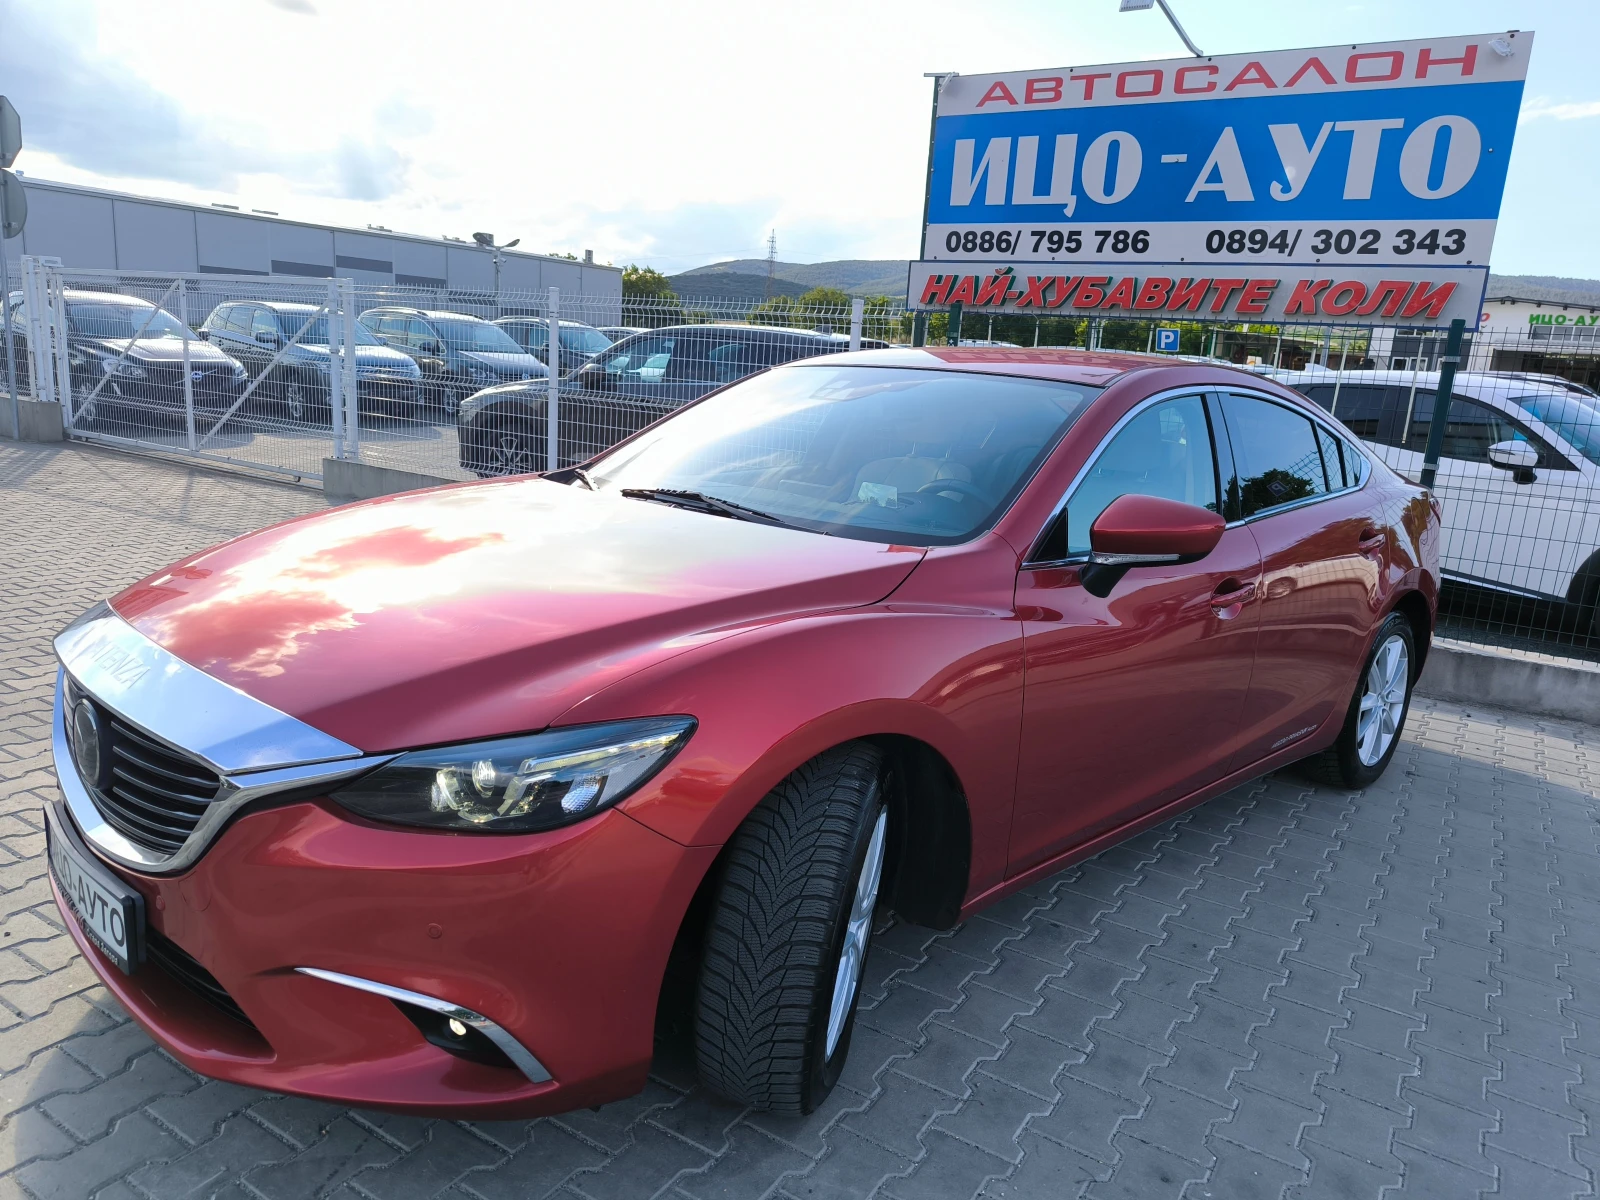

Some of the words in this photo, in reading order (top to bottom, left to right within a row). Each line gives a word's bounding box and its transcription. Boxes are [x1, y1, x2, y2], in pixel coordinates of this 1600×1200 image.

[975, 44, 1479, 108] АВТОСАЛОН
[945, 229, 1022, 255] 0886/
[1029, 230, 1083, 254] 795
[1093, 229, 1151, 254] 786
[1205, 228, 1303, 257] 0894/
[1310, 229, 1382, 255] 302
[1391, 228, 1467, 255] 343
[919, 266, 1281, 314] НАЙ-ХУБАВИТЕ
[1283, 279, 1459, 319] КОЛИ
[1160, 331, 1175, 349] P
